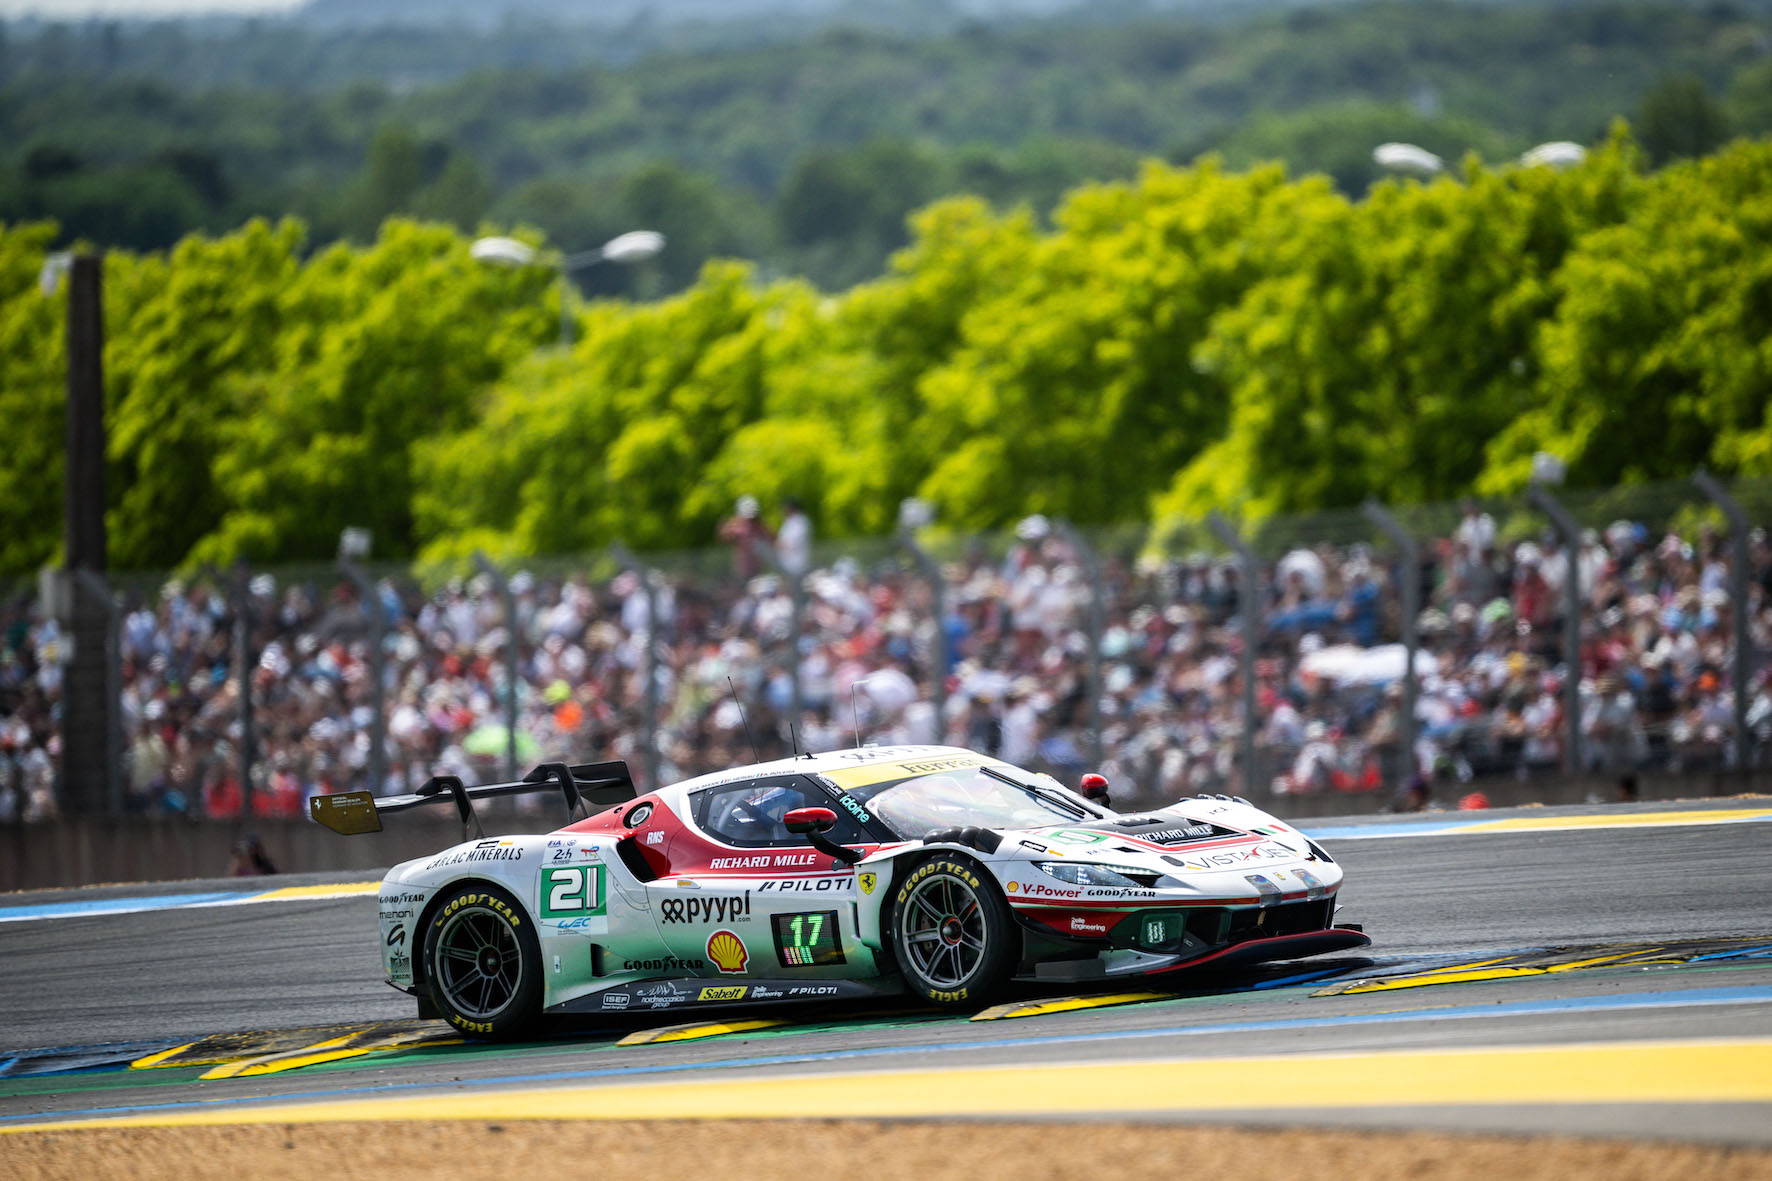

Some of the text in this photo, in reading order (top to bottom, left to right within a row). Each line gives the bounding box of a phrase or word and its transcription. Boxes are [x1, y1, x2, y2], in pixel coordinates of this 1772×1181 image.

[839, 794, 870, 823] idoine
[647, 831, 665, 845] RNS
[1186, 825, 1213, 836] MILLE
[426, 848, 524, 870] CARLAC MINERALS
[710, 854, 816, 869] RICHARD MILLE
[906, 861, 980, 889] GOODYEAR
[549, 866, 598, 911] 21
[779, 878, 853, 892] PILOTI
[379, 892, 425, 904] GOODYEAR
[1087, 888, 1156, 898] GOODYEAR
[444, 893, 520, 927] GOODYEAR
[686, 889, 750, 923] pyypl
[557, 917, 591, 929] WEC
[789, 914, 823, 947] 17
[1071, 922, 1106, 932] Engineering
[624, 955, 704, 972] GOODYEAR
[703, 988, 742, 999] Sabelt
[800, 987, 837, 995] PILOTI
[928, 987, 969, 1002] EAGLE
[605, 995, 628, 1003] ISEF
[452, 1014, 494, 1033] EAGLE
